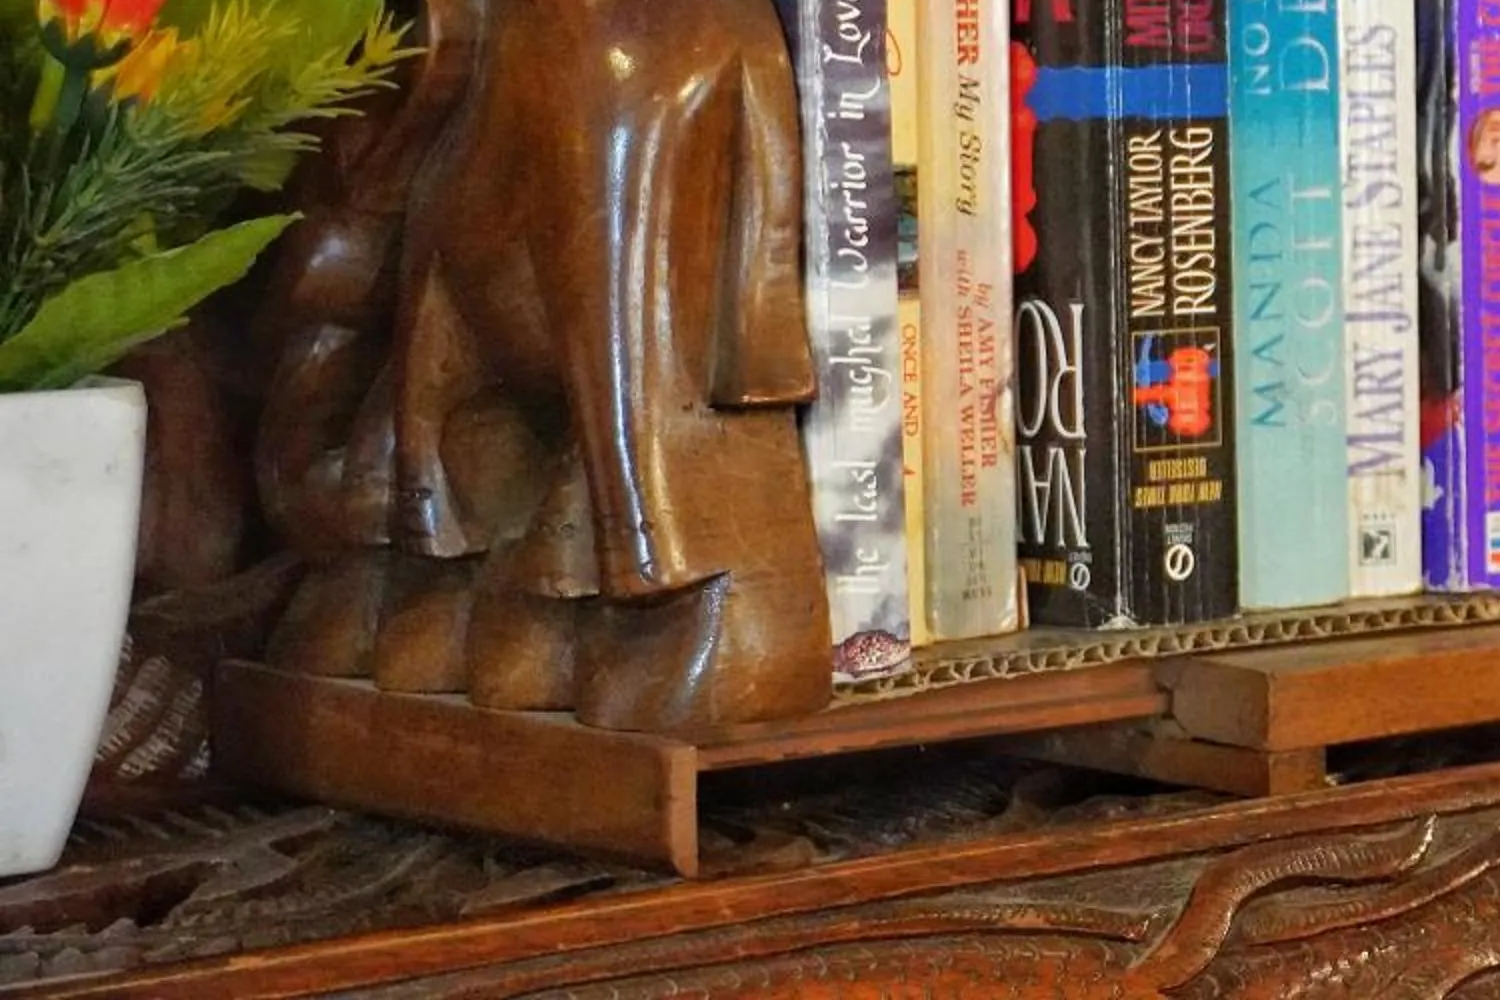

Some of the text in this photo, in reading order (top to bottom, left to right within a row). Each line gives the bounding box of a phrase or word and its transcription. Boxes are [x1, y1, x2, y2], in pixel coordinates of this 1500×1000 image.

[826, 77, 880, 122] in
[1240, 21, 1273, 96] NO
[1343, 22, 1403, 210] STAPLES
[952, 72, 983, 218] My Story
[823, 141, 871, 293] Warrior
[954, 248, 977, 299] with
[1128, 128, 1168, 319] NANCY TAYLOR
[1171, 126, 1218, 317] ROSENBERG
[1248, 175, 1288, 430] MANDA
[1288, 170, 1339, 427] SCOTT
[1344, 222, 1413, 336] JANE
[828, 314, 892, 434] mughal
[902, 323, 919, 438] ONCE AND
[955, 304, 977, 398] SHEILA
[973, 281, 999, 471] by AMY FISHER
[1345, 340, 1409, 481] MARY
[829, 460, 881, 524] last
[957, 403, 979, 508] WELLER
[1016, 446, 1092, 549] NA
